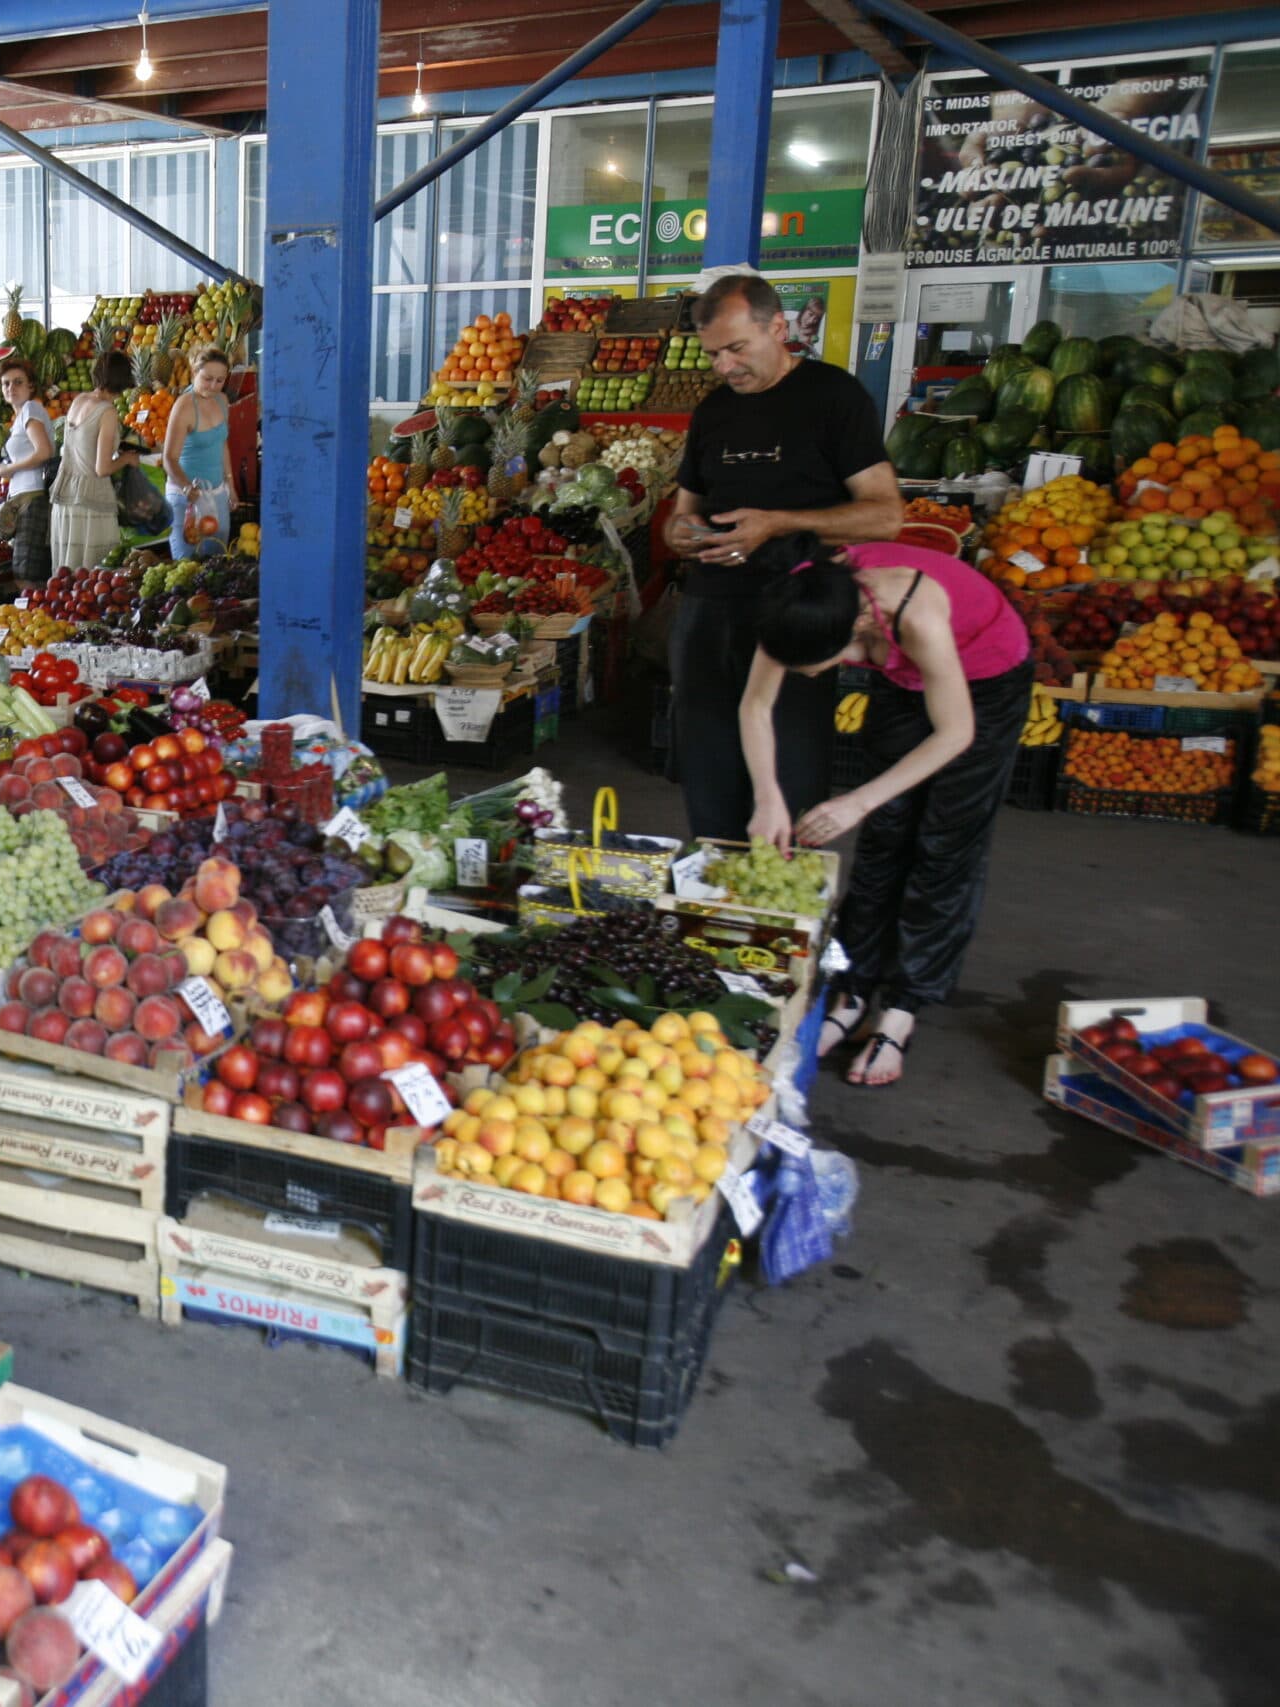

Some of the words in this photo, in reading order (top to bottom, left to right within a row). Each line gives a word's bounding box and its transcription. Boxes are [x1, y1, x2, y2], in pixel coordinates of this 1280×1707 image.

[924, 100, 943, 112] SC
[945, 96, 990, 111] MIDAS
[994, 92, 1036, 106] IMPO
[1064, 84, 1112, 99] PORT
[1121, 78, 1174, 94] GROUP
[1178, 74, 1209, 90] SRL
[925, 119, 1018, 137] IMPORTATOR
[990, 133, 1043, 148] DIRECT
[1050, 130, 1078, 144] DIN
[938, 165, 1062, 194] MASLINE
[935, 205, 991, 232] ULEI
[999, 205, 1035, 230] DE
[1044, 195, 1175, 227] MASLINE
[907, 248, 973, 264] PRODUSE
[976, 246, 1051, 262] AGRICOLE
[1055, 242, 1136, 260] NATURALE
[1141, 240, 1182, 256] 100%
[57, 1097, 91, 1114] Star
[55, 1149, 89, 1166] Star
[458, 1191, 492, 1213] Red
[497, 1199, 538, 1220] Star
[543, 1210, 629, 1240] Romantic
[204, 1244, 273, 1270] Romantic
[279, 1263, 313, 1280] Star
[317, 1270, 348, 1289] Red
[216, 1292, 319, 1331] PRIAMOS
